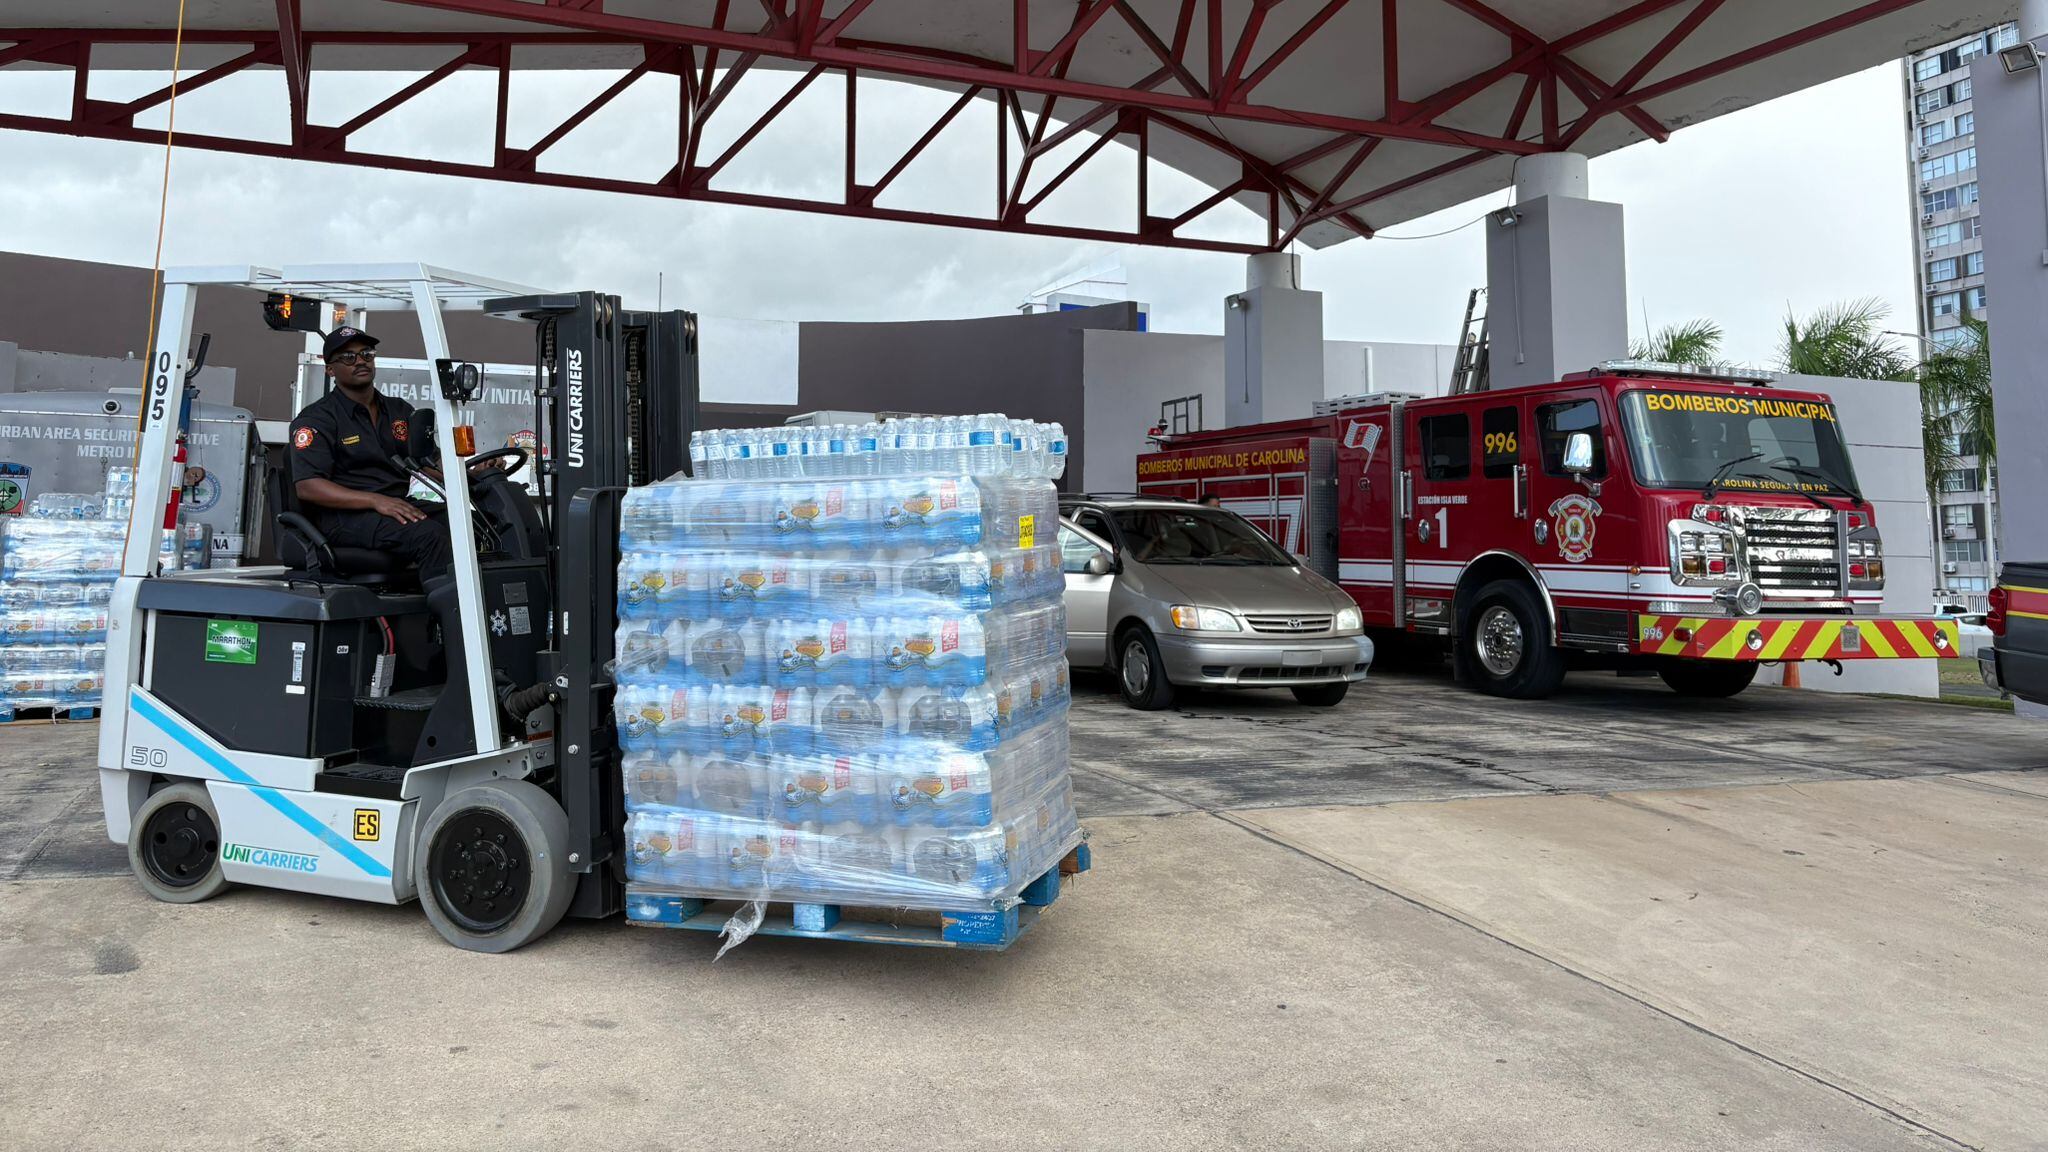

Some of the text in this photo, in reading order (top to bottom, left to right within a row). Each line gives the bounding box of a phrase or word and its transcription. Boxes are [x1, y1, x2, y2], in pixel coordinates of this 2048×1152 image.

[151, 351, 171, 421] 095
[380, 382, 418, 401] AREA
[1645, 393, 1836, 423] BOMBEROS MUNICIPAL
[0, 425, 41, 439] RBAN
[43, 426, 82, 440] AREA
[84, 428, 138, 442] SECURIT
[1484, 431, 1517, 454] 996
[77, 444, 124, 458] METRO
[1138, 447, 1306, 475] BOMBEROS MUNICIPAL DE CAROLINA
[1712, 479, 1758, 489] CROLINA
[1801, 482, 1813, 491] EN
[1814, 484, 1829, 492] PAZ
[1435, 507, 1448, 549] 1
[212, 538, 230, 550] NA
[211, 635, 252, 645] MARATHON
[1643, 626, 1664, 640] 996
[131, 745, 168, 768] 50
[356, 814, 377, 836] ES
